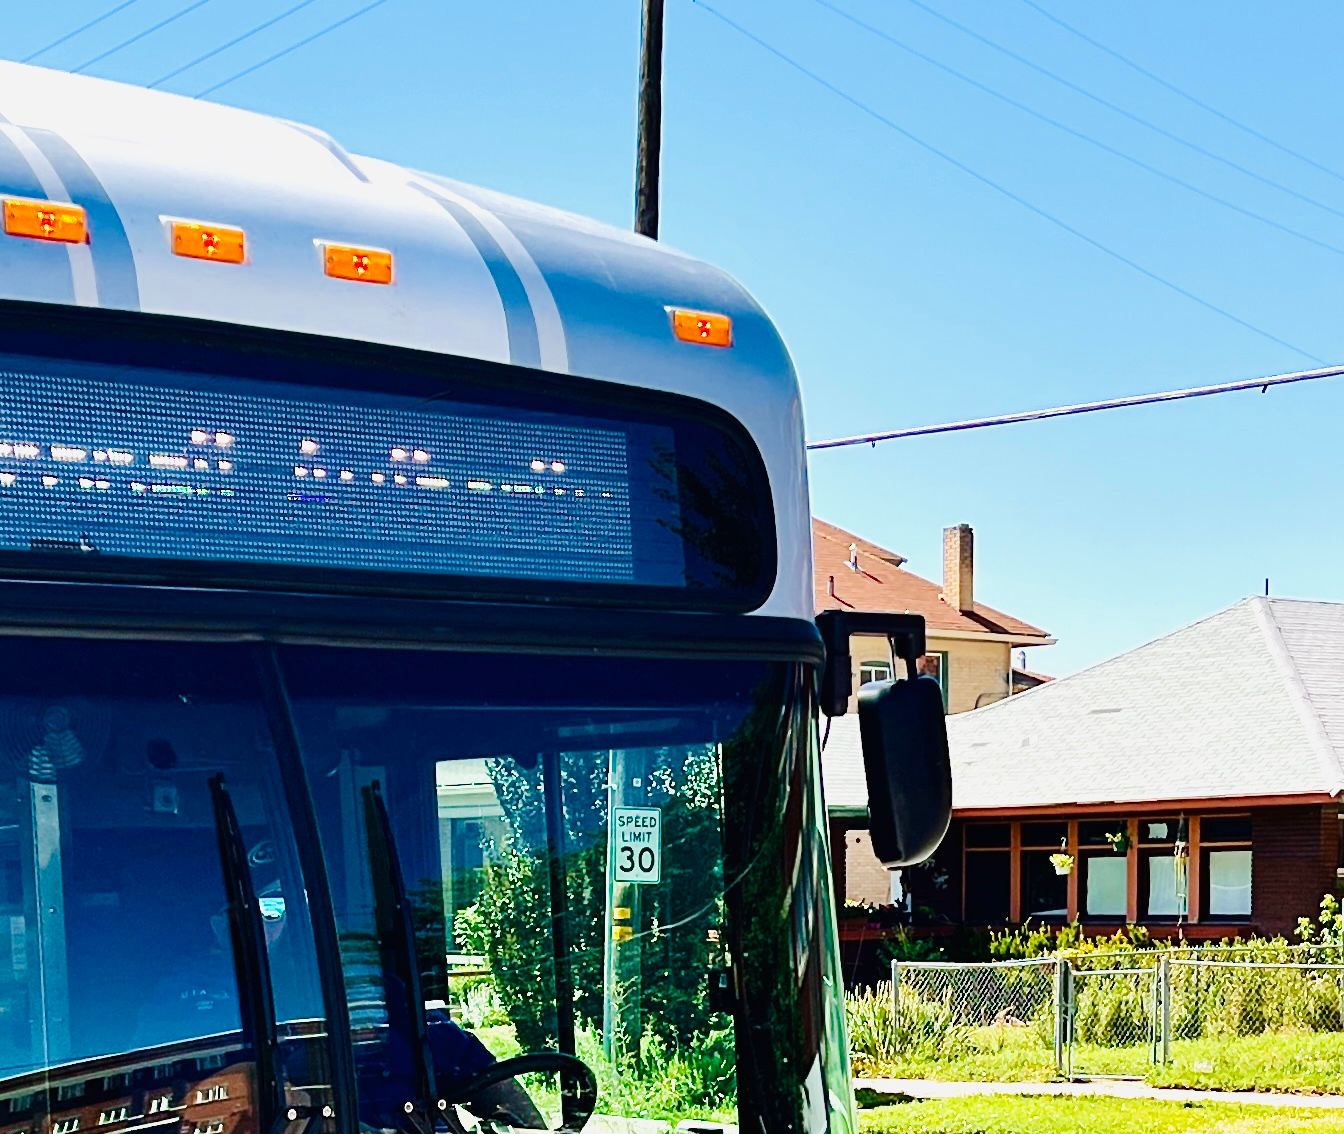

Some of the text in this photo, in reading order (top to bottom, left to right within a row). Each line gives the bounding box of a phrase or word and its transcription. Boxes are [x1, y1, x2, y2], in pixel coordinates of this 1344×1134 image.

[618, 815, 656, 828] SPEED
[621, 831, 652, 843] LIMIT
[619, 846, 655, 873] 30
